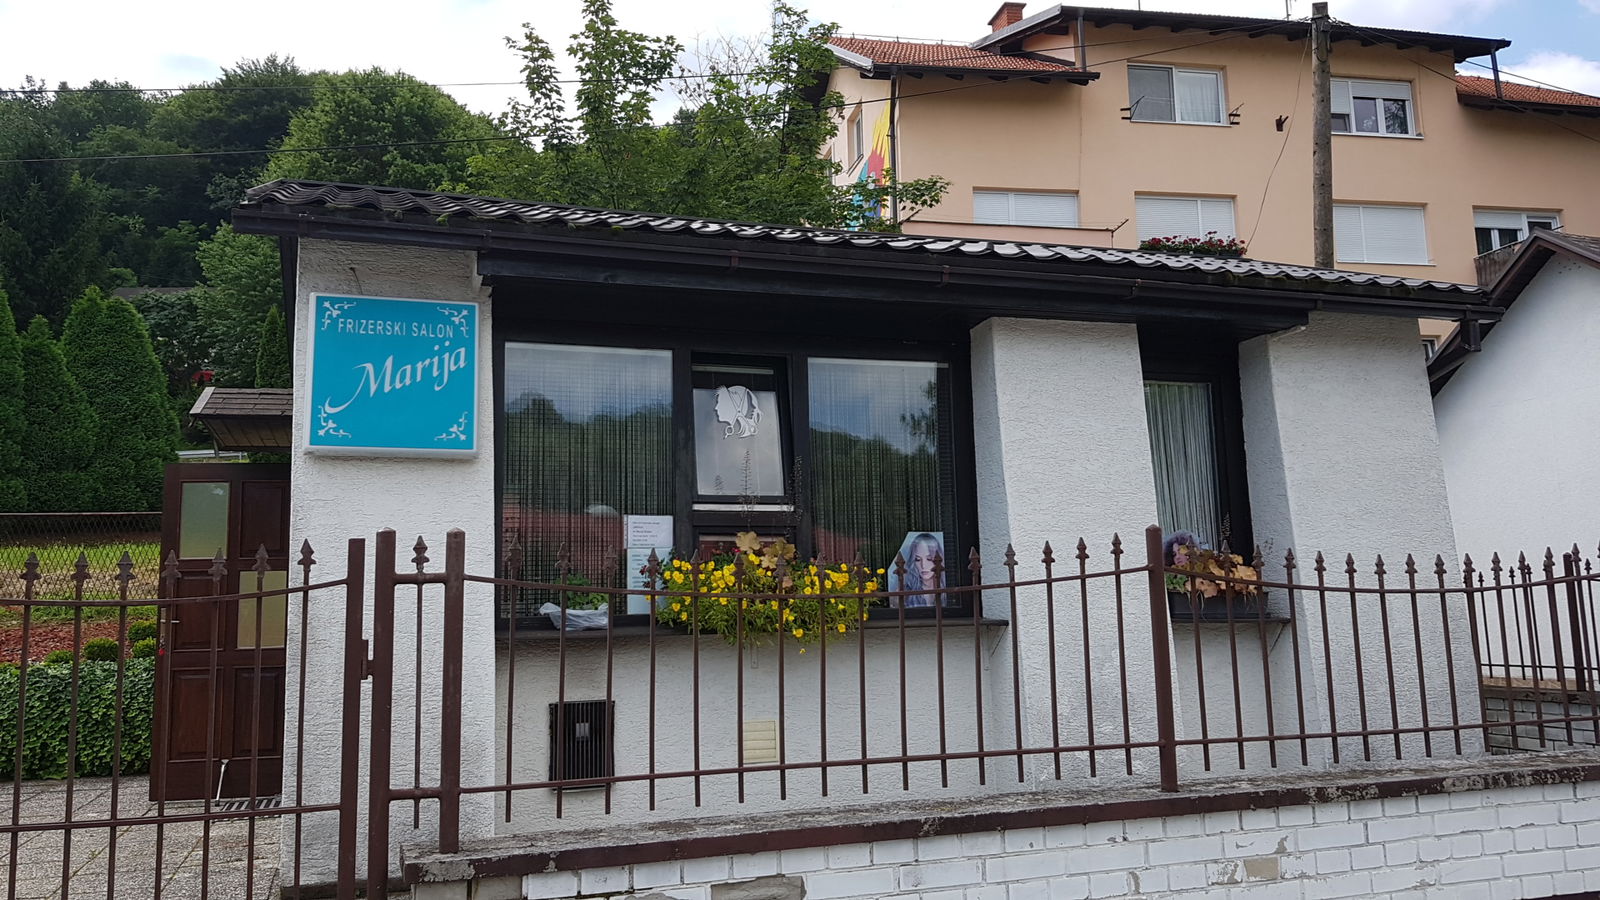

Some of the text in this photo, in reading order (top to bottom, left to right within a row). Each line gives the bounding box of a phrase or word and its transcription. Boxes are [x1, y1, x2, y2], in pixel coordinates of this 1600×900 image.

[338, 318, 454, 338] FRIZERSKI SALON
[324, 341, 467, 413] Marija
